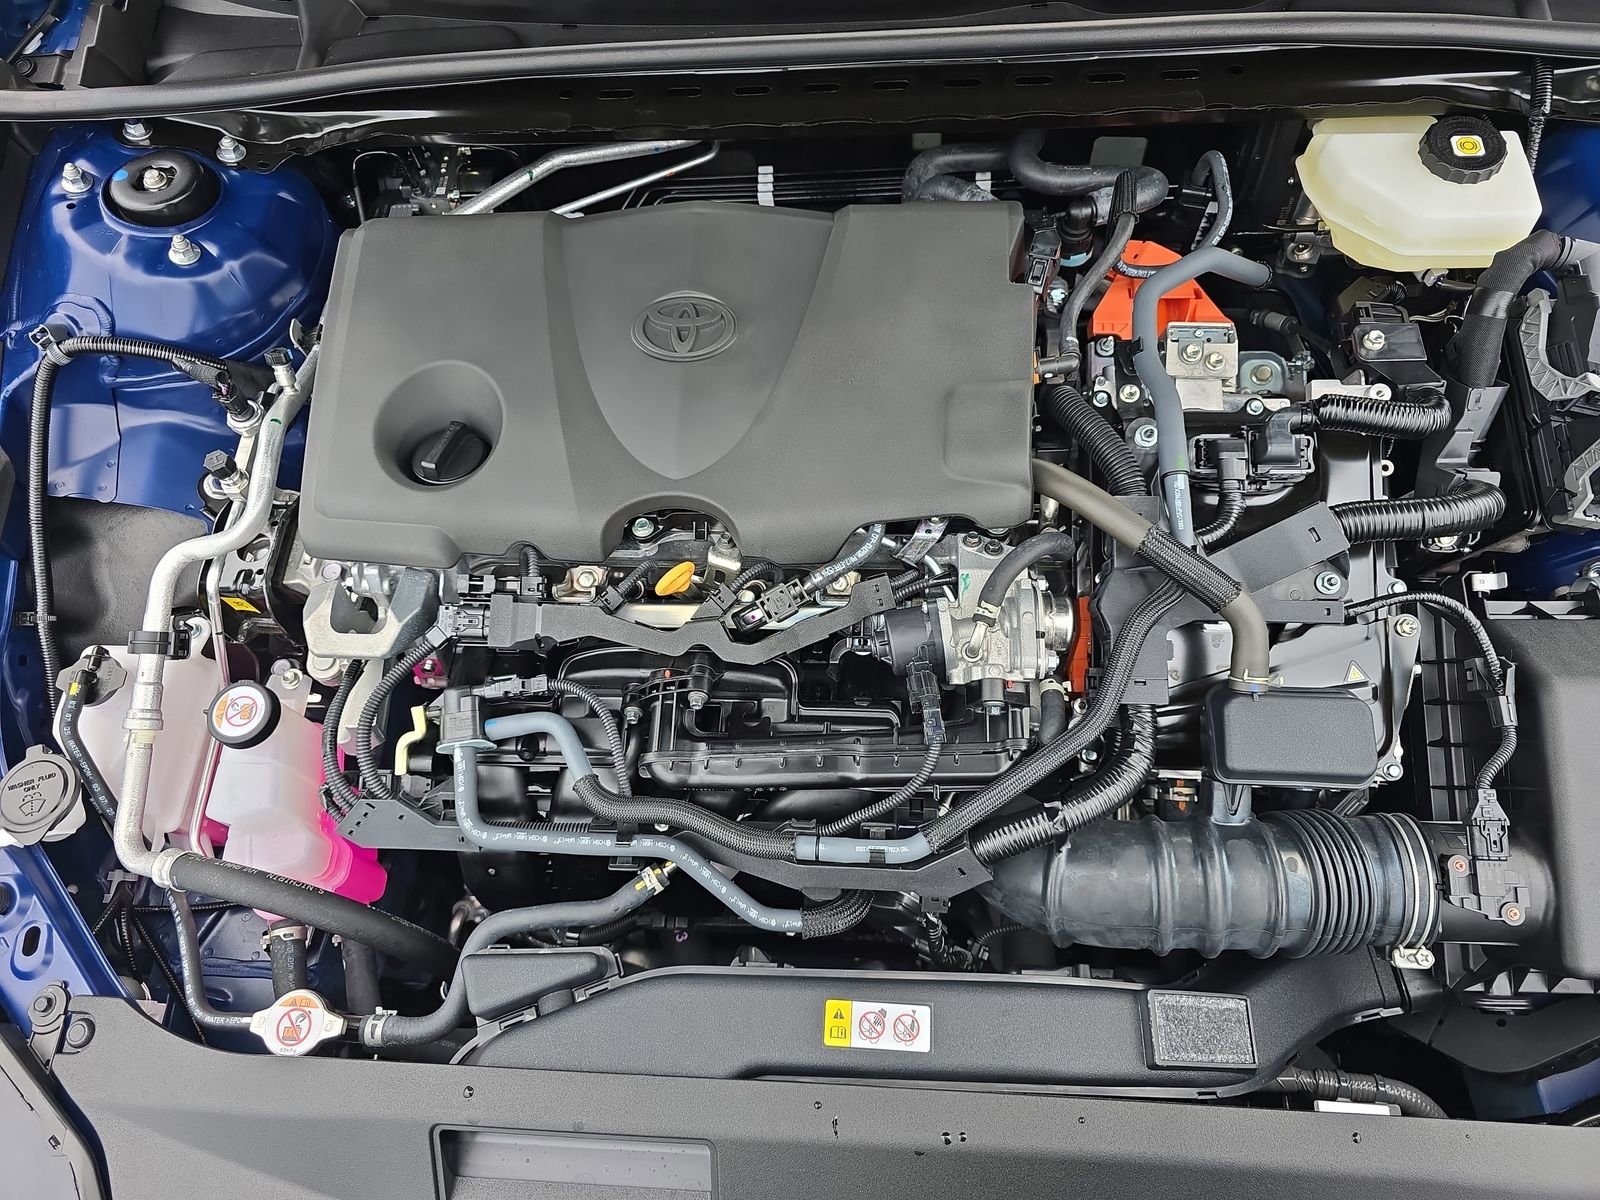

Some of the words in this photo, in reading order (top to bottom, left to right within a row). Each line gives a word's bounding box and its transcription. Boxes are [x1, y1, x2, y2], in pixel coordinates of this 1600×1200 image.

[67, 739, 82, 759] WATER
[91, 783, 99, 792] 03
[99, 795, 108, 805] 07
[7, 779, 35, 792] WASHER
[38, 772, 57, 783] FLUID
[23, 783, 41, 793] ONLY
[204, 1015, 224, 1025] WATER
